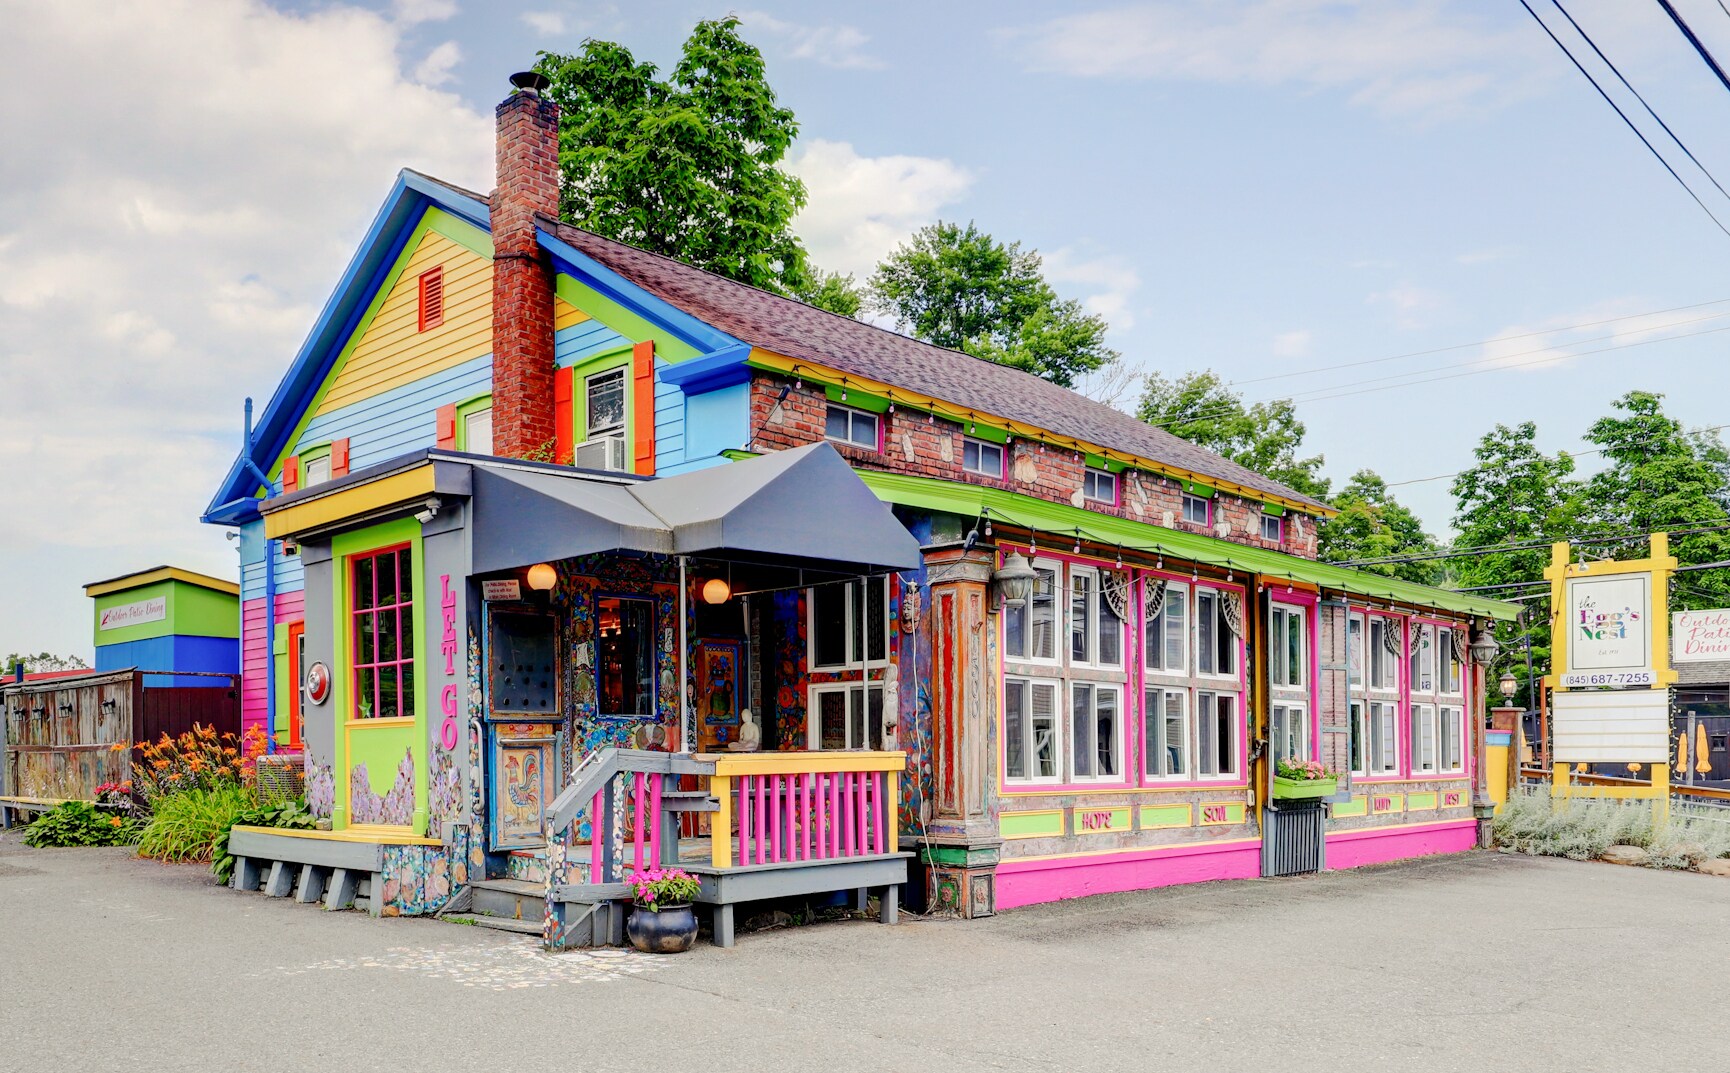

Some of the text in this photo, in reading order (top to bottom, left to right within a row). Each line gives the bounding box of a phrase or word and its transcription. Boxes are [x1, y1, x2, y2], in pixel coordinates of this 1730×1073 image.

[1578, 595, 1596, 608] the
[1578, 606, 1640, 629] Egg's
[1578, 625, 1628, 641] Nest
[440, 574, 458, 751] LET GO
[1566, 673, 1649, 685] (845) 687-7255
[1082, 811, 1112, 830] HOPE
[1203, 805, 1228, 823] SOUL
